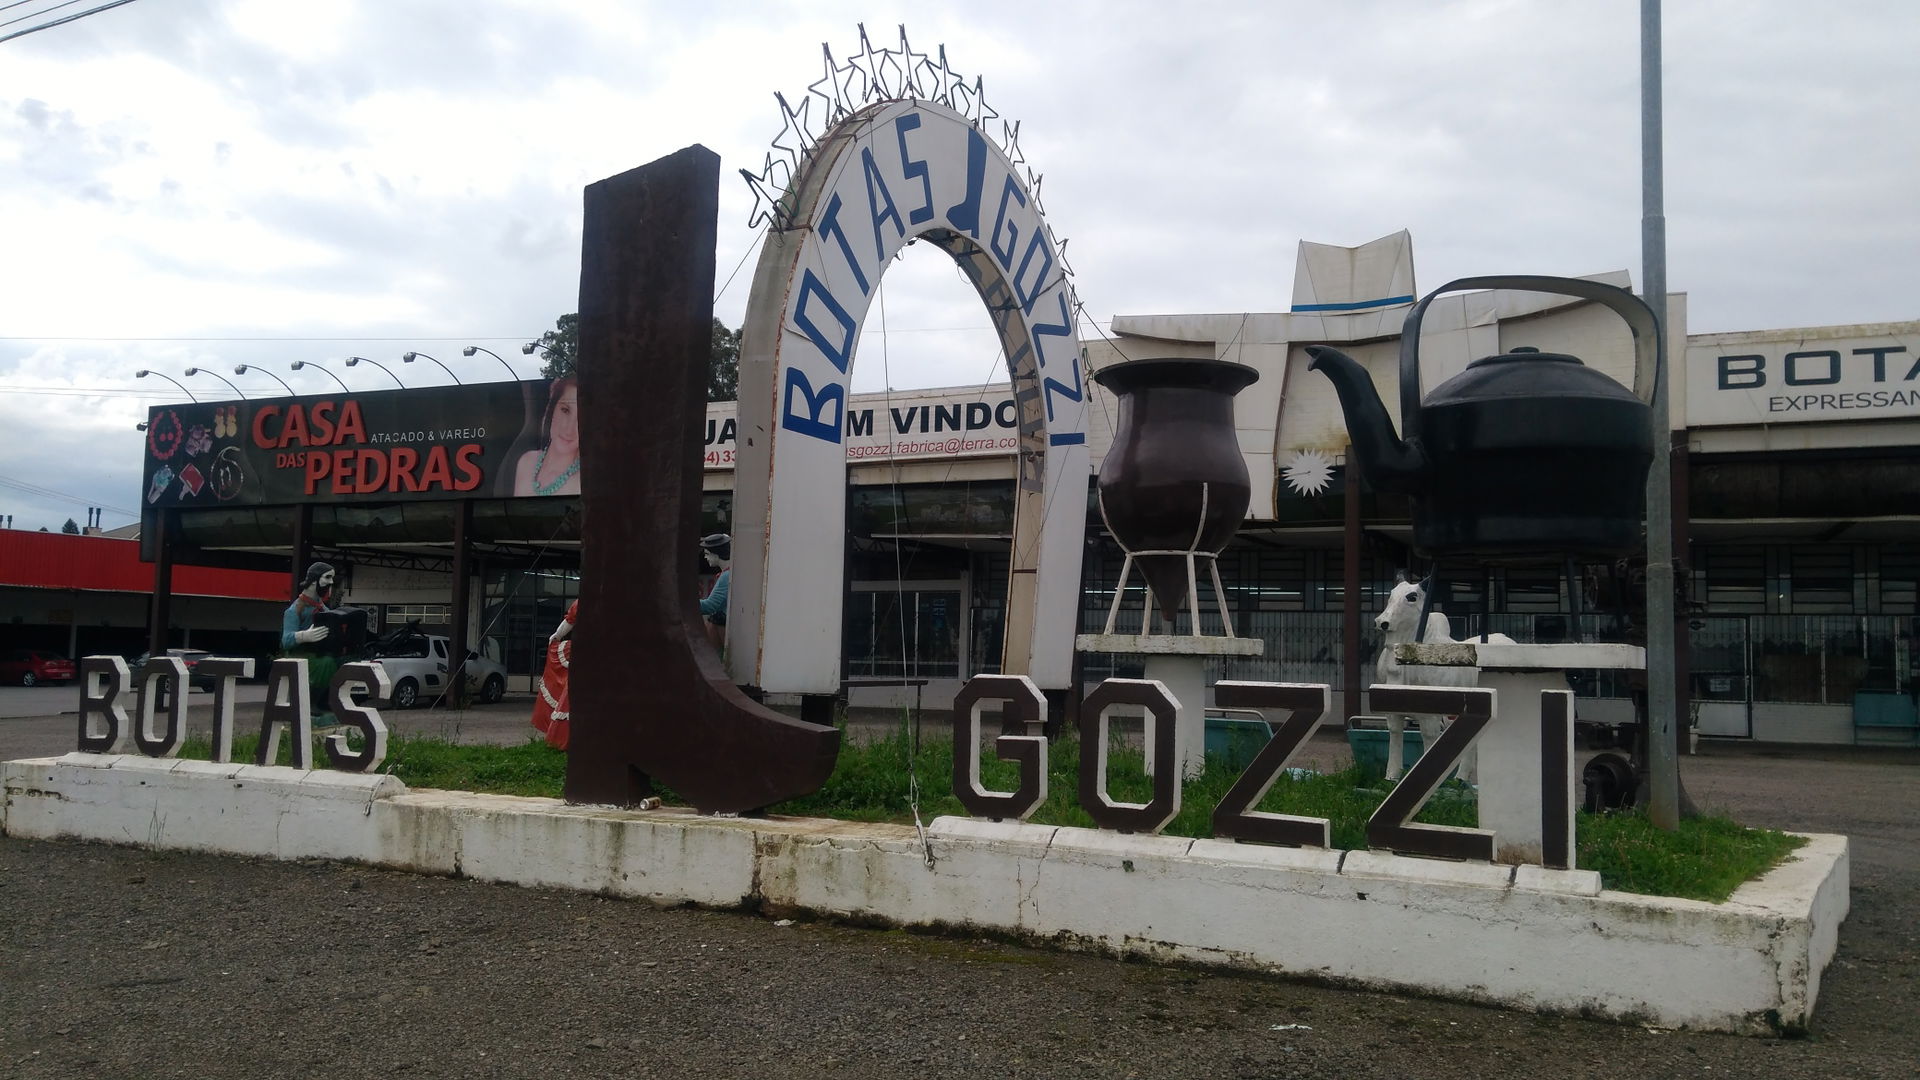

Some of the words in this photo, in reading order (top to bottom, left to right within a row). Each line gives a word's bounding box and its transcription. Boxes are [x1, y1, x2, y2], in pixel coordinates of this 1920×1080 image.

[782, 112, 934, 444] BOTAS
[990, 173, 1085, 446] GOZZI
[252, 400, 368, 449] CASA
[371, 431, 425, 443] ATACADO
[428, 431, 435, 441] &
[439, 427, 486, 441] VAREJO
[890, 400, 1017, 435] VINDO
[276, 452, 307, 468] DAS
[304, 444, 484, 495] PEDRAS
[845, 437, 1017, 459] sgozzi.fabrica@terra.co
[77, 655, 391, 773] BOTAS
[953, 674, 1576, 871] GOZZI
